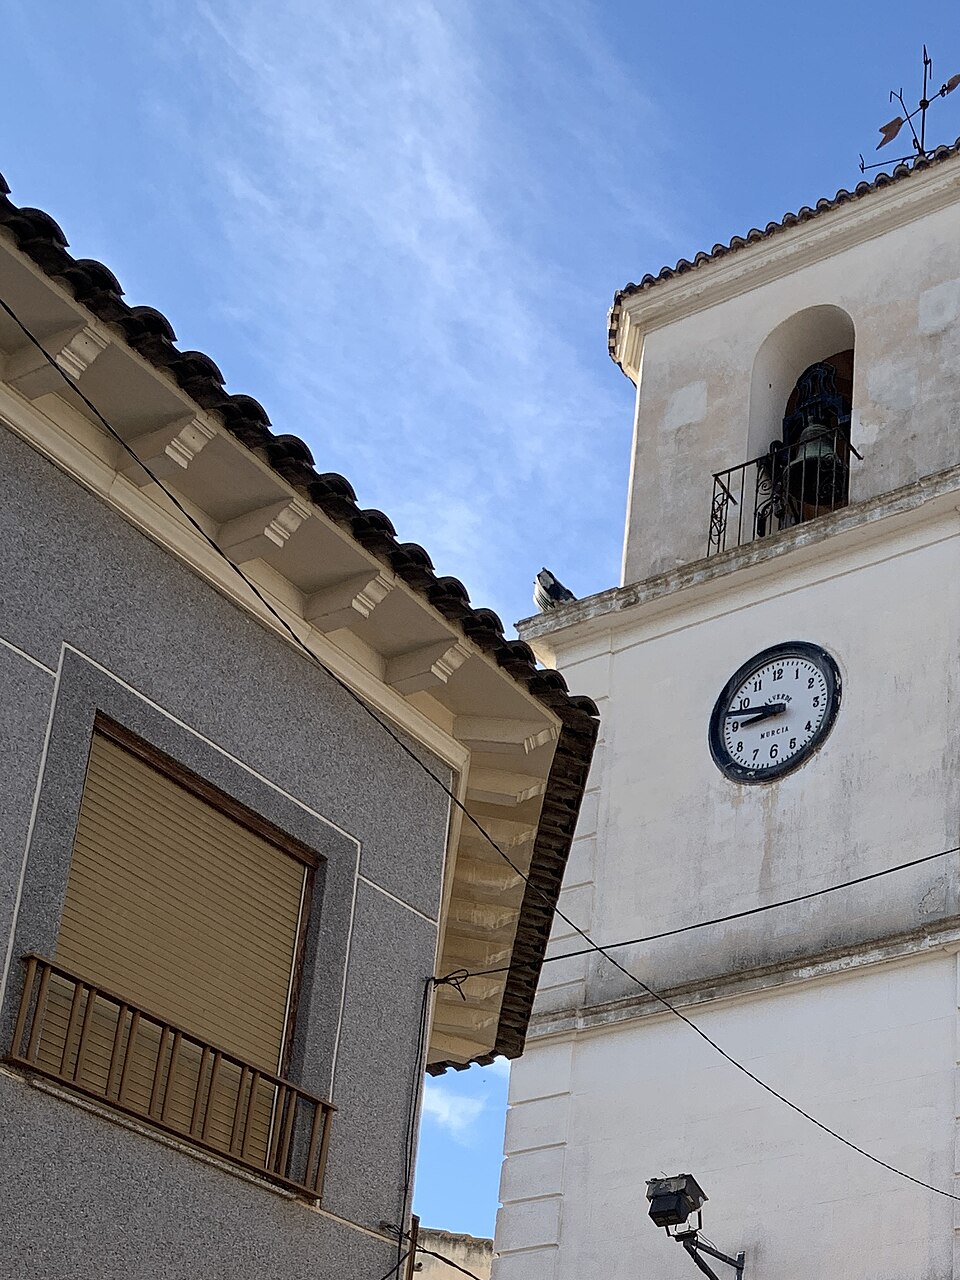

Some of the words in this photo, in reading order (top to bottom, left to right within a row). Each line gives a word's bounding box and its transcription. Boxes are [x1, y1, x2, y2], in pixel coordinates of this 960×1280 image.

[773, 669, 783, 681] 12
[795, 669, 799, 680] 1
[754, 680, 762, 692] 11
[808, 678, 814, 689] 2
[739, 698, 750, 710] 10
[813, 696, 819, 708] 3
[732, 721, 739, 732] 9
[804, 720, 811, 731] 4
[760, 725, 789, 739] MURCIA
[737, 742, 743, 752] 8
[789, 738, 796, 749] 5
[753, 749, 759, 760] 7
[770, 744, 778, 759] 6
